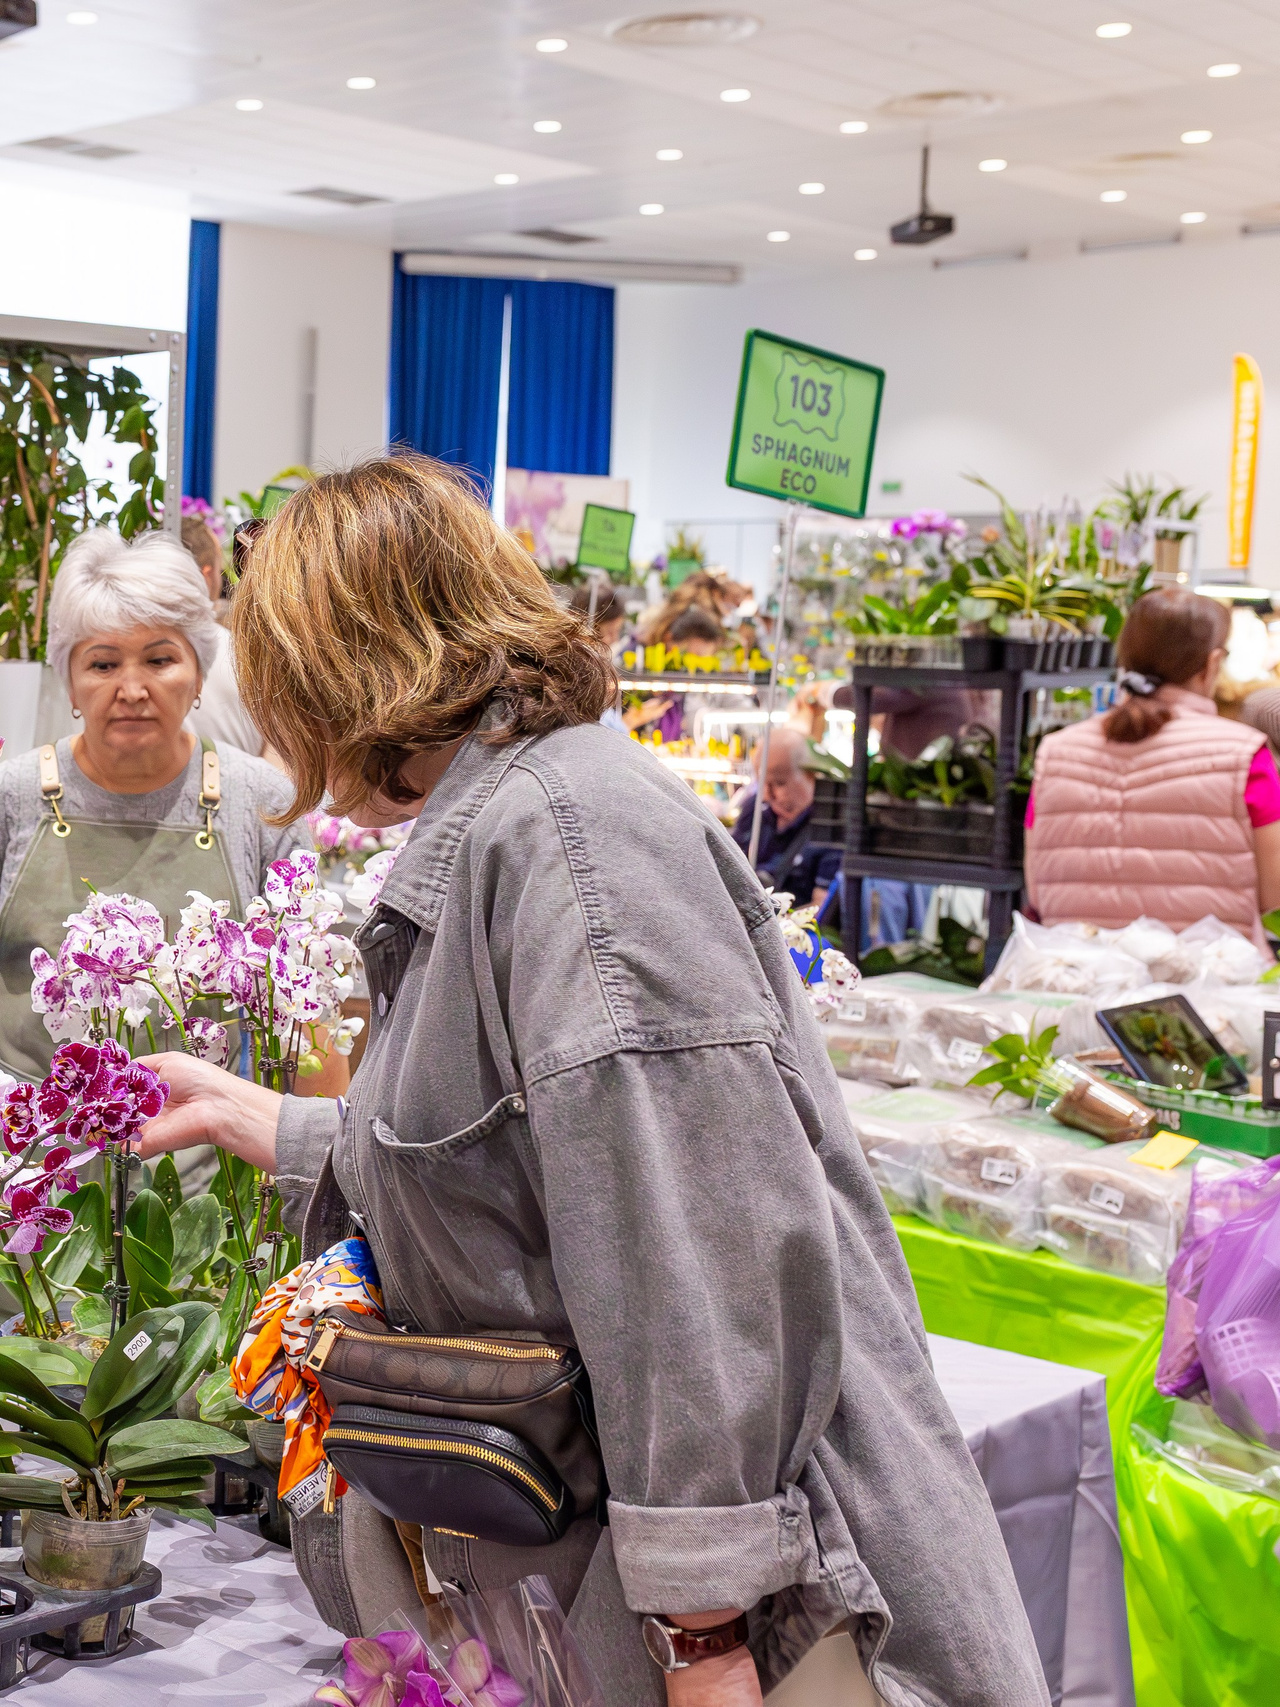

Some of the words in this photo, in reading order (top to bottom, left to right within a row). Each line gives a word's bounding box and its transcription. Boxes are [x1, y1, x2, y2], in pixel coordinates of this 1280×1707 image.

[790, 374, 833, 417] 103
[752, 433, 850, 478] SPHAGNUM
[780, 468, 817, 494] ECO
[128, 1335, 147, 1356] 2900
